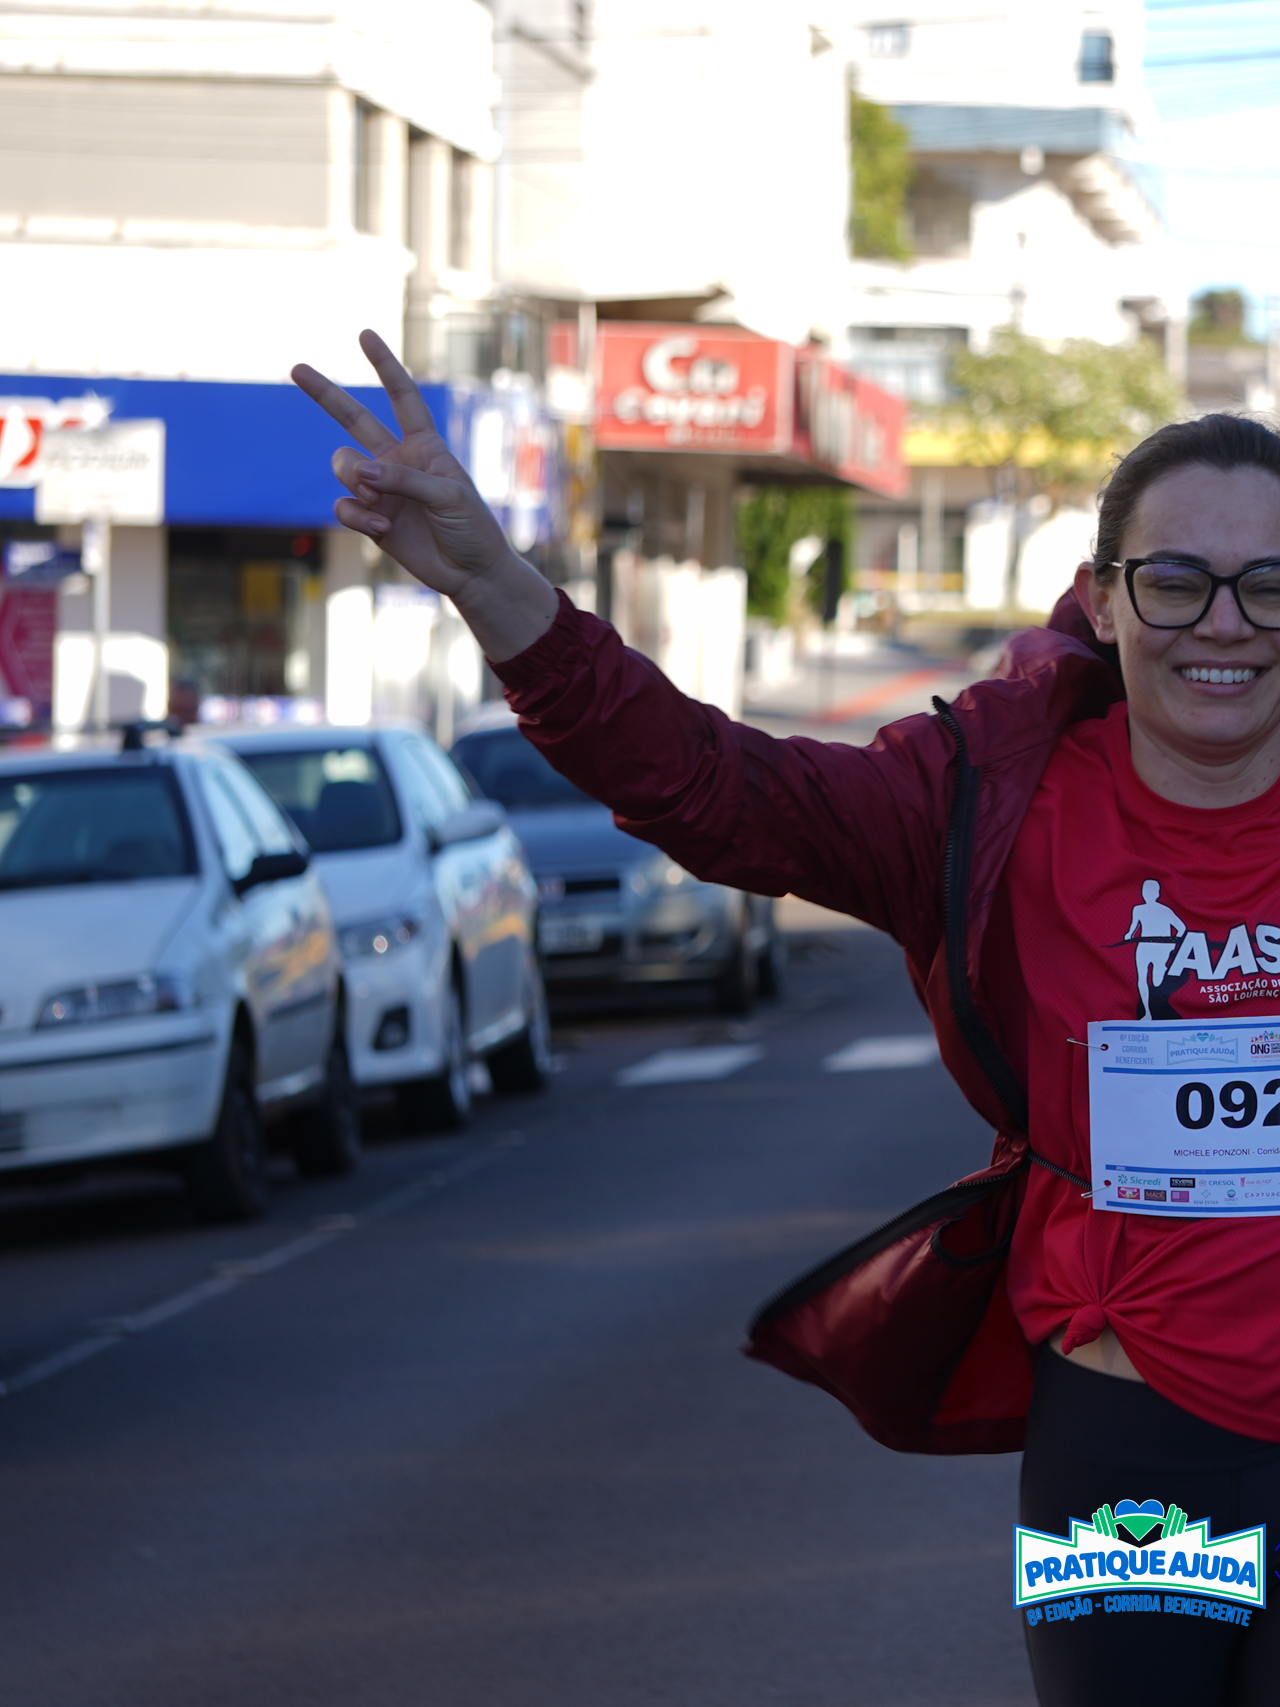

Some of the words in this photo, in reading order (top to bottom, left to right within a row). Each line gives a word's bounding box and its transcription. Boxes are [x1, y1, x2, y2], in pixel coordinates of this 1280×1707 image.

[1200, 978, 1268, 994] ASSOCIAÇÃO
[1208, 993, 1229, 1003] SÃO
[1128, 1034, 1150, 1043] EDIÇÃO
[1122, 1045, 1148, 1054] CORRIDA
[1170, 1047, 1209, 1057] PRATIQUE
[1210, 1047, 1235, 1056] AJUDA
[1250, 1043, 1271, 1055] ONG
[1115, 1056, 1155, 1066] BENEFICENTE
[1173, 1149, 1211, 1157] MICHELE
[1213, 1148, 1250, 1156] PONZONI
[1130, 1176, 1161, 1186] Sicredi
